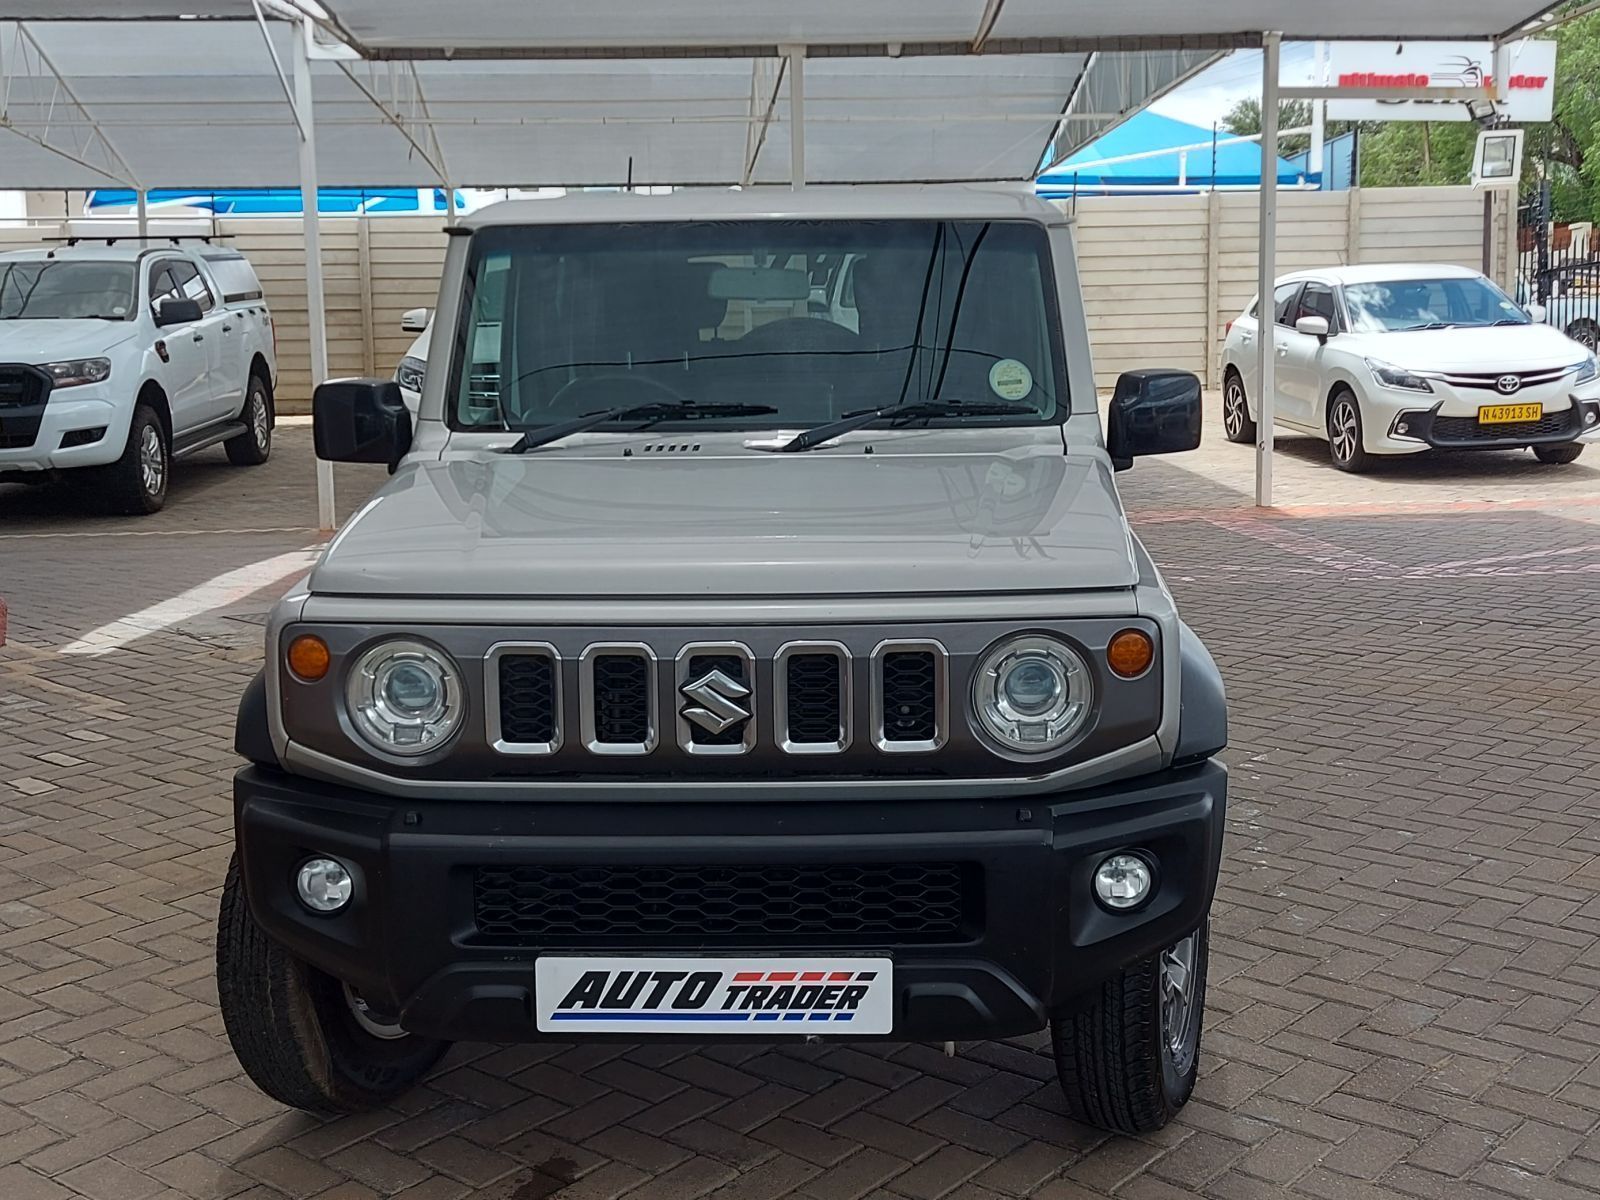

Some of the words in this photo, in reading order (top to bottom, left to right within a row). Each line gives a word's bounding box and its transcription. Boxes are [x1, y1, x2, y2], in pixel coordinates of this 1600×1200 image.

[1482, 408, 1489, 421] N
[1491, 407, 1523, 420] 43913
[1525, 406, 1538, 418] SH
[557, 971, 723, 1009] AUTO
[720, 985, 869, 1010] TRADER
